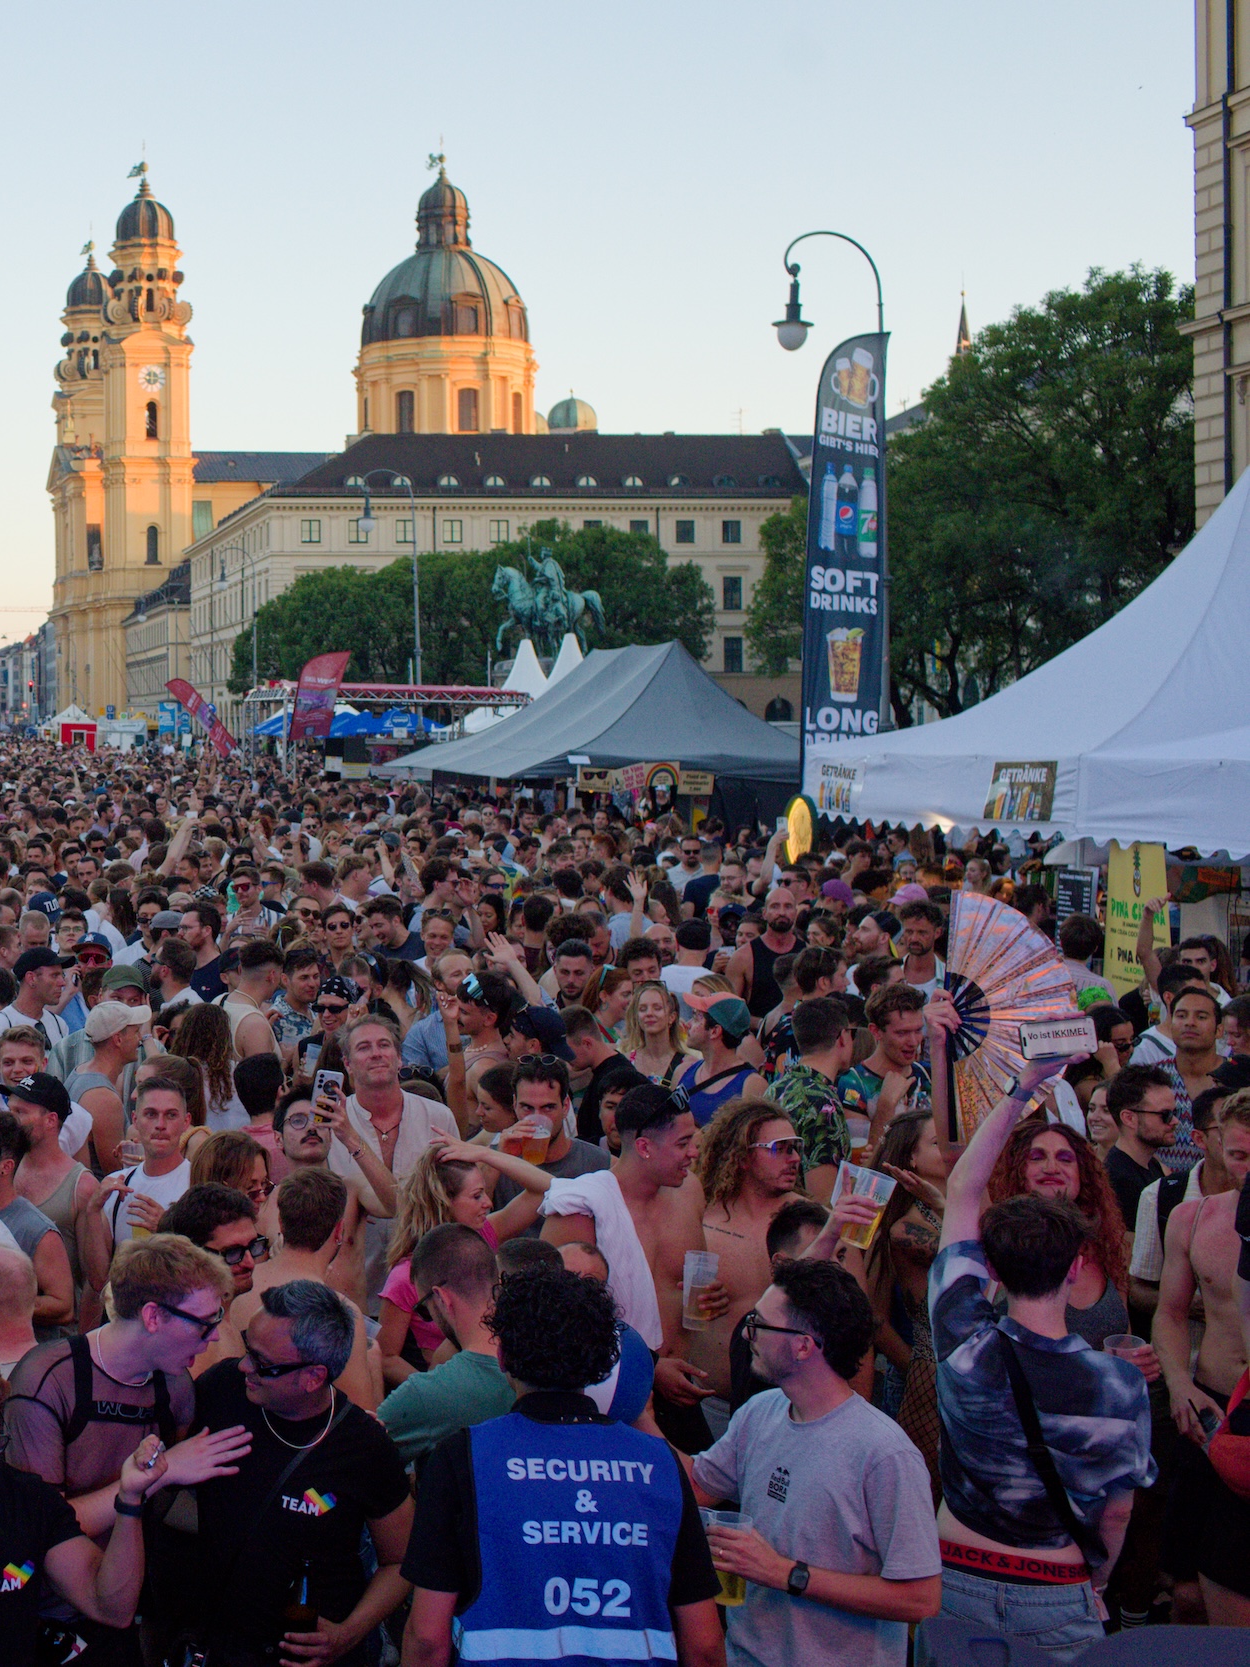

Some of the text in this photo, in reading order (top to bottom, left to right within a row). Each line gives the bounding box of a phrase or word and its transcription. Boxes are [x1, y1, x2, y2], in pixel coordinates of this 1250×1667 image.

[821, 406, 877, 444] BIER
[855, 443, 879, 458] HIER
[810, 565, 879, 596] SOFT
[810, 591, 878, 616] DRINKS
[805, 706, 879, 734] LONG
[821, 763, 857, 780] GETRÄNKE
[1000, 764, 1047, 783] GETRÄNKE
[1039, 1031, 1051, 1039] ist
[1052, 1027, 1088, 1038] IKKIMEL
[506, 1457, 654, 1484] SECURITY
[768, 1480, 787, 1496] BORA
[281, 1495, 320, 1517] TEAM
[574, 1489, 599, 1513] &
[522, 1520, 649, 1547] SERVICE
[942, 1544, 993, 1566] JACK
[996, 1556, 1010, 1568] &
[1014, 1559, 1077, 1579] JONES
[544, 1576, 631, 1618] 052
